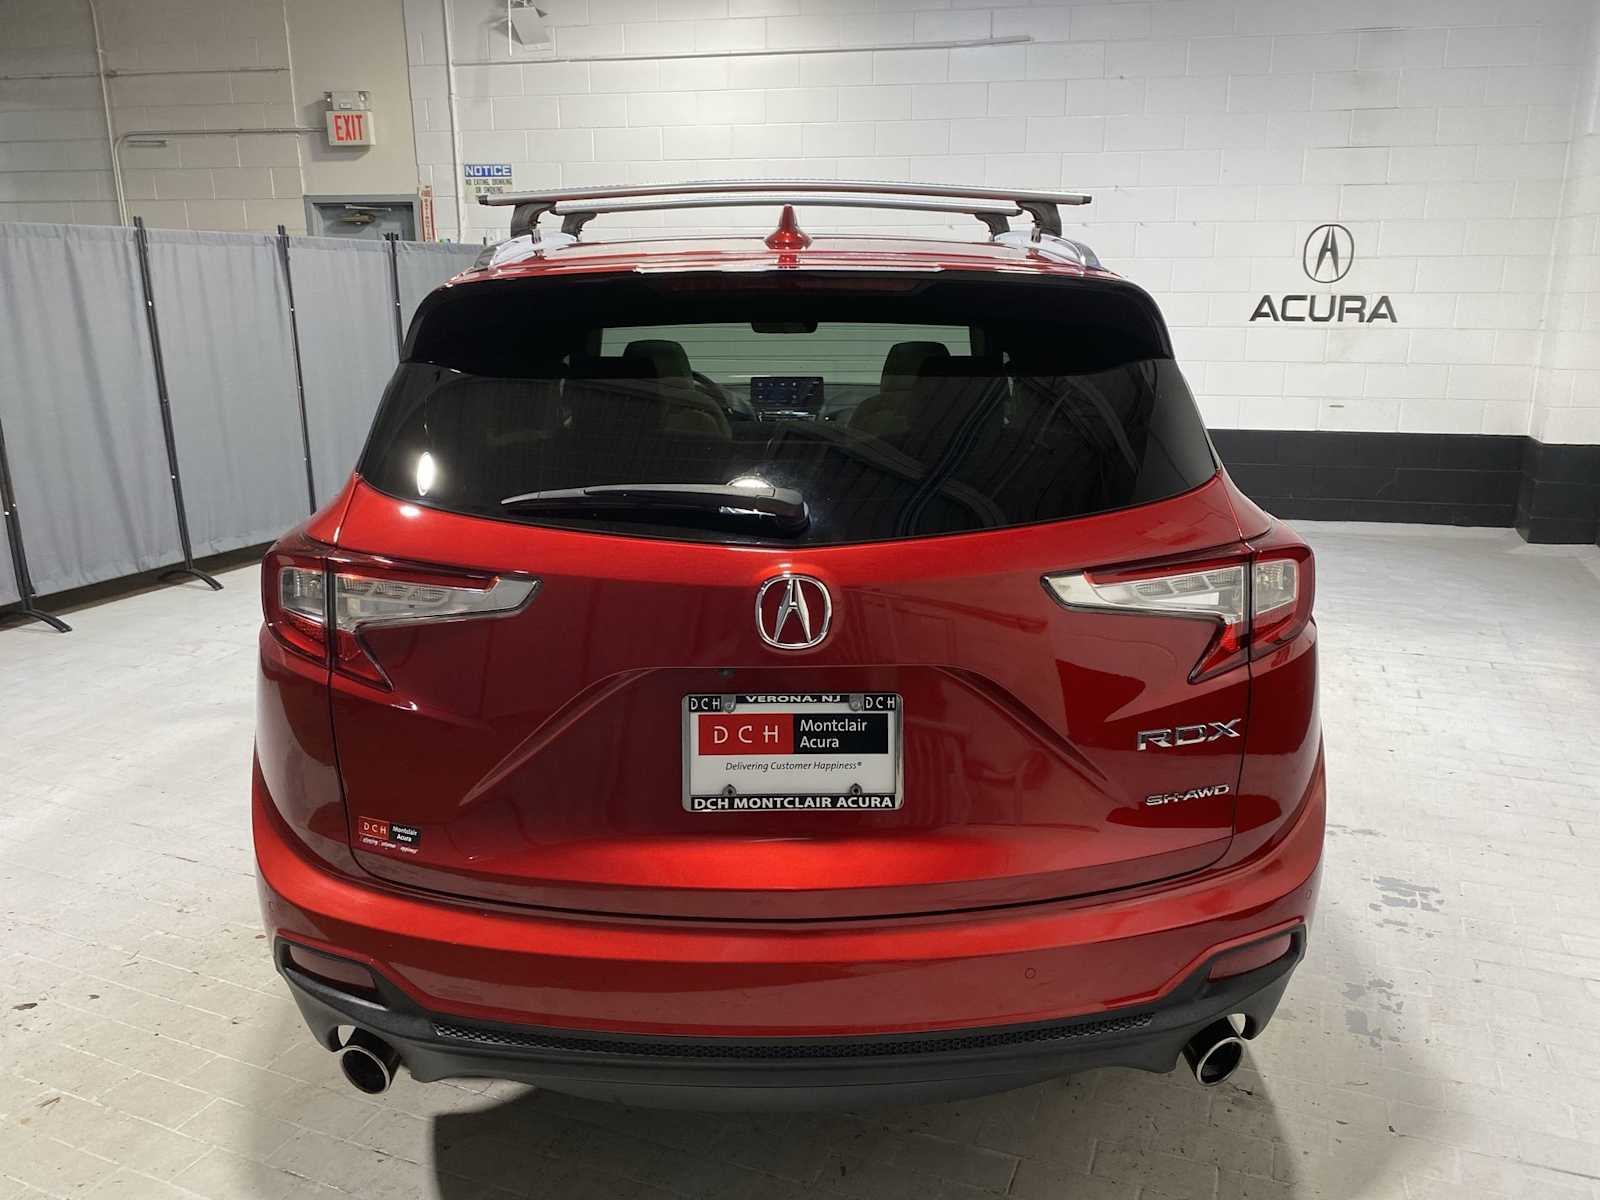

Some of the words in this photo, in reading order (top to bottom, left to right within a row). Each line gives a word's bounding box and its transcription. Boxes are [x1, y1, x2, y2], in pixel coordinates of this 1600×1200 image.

[334, 114, 365, 141] EXIT
[465, 165, 512, 176] NOTICE
[1249, 294, 1398, 323] ACURA
[690, 697, 721, 711] DCH
[745, 695, 817, 703] VERONA,
[821, 695, 841, 703] NJ
[865, 696, 896, 709] DCH
[800, 719, 868, 732] Montclair
[713, 725, 779, 744] DCH
[1137, 717, 1242, 751] RDX
[800, 736, 839, 748] Acura
[725, 761, 768, 772] Delivering
[770, 761, 812, 770] Customer
[1145, 784, 1230, 806] SH-AWD
[693, 797, 729, 809] DCH
[733, 797, 832, 809] MONTCLAIR
[836, 796, 893, 808] ACURA
[396, 833, 412, 842] Acura
